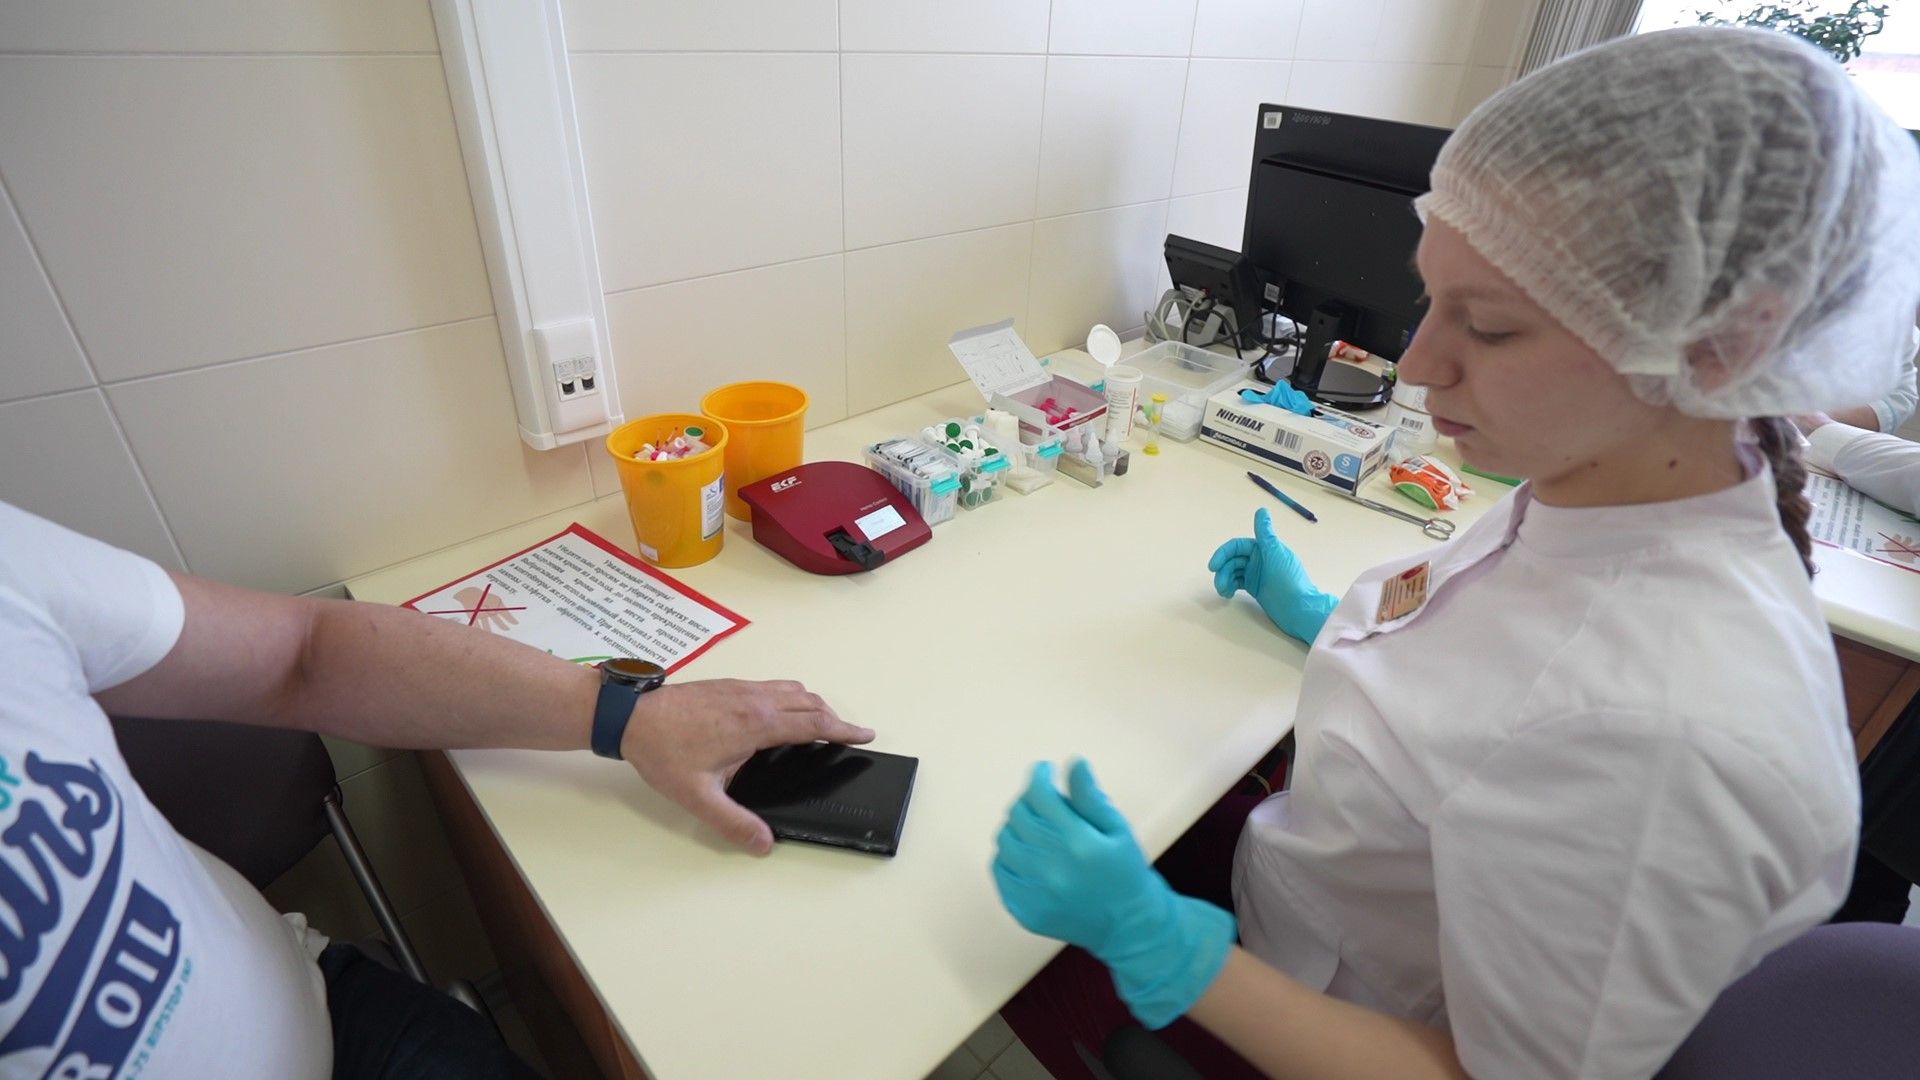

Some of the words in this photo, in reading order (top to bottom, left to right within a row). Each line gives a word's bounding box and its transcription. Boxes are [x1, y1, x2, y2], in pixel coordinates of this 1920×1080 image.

[1216, 408, 1265, 432] NitriMAX
[1311, 458, 1323, 468] 25
[1342, 456, 1351, 468] S
[601, 559, 644, 584] Уважаемые
[520, 582, 553, 604] салфетки
[554, 605, 595, 631] обратитесь
[560, 559, 583, 572] крови
[648, 611, 701, 641] прекращения
[561, 583, 620, 619] использованный
[615, 617, 653, 640] материал
[650, 638, 679, 656] только
[571, 577, 595, 592] крови
[622, 608, 646, 623] места
[592, 566, 621, 583] просим
[623, 586, 656, 604] убирать
[653, 601, 689, 622] салфетку
[686, 619, 711, 633] после
[595, 617, 614, 629] При
[609, 627, 668, 663] необходимости
[95, 919, 174, 1029] OIL
